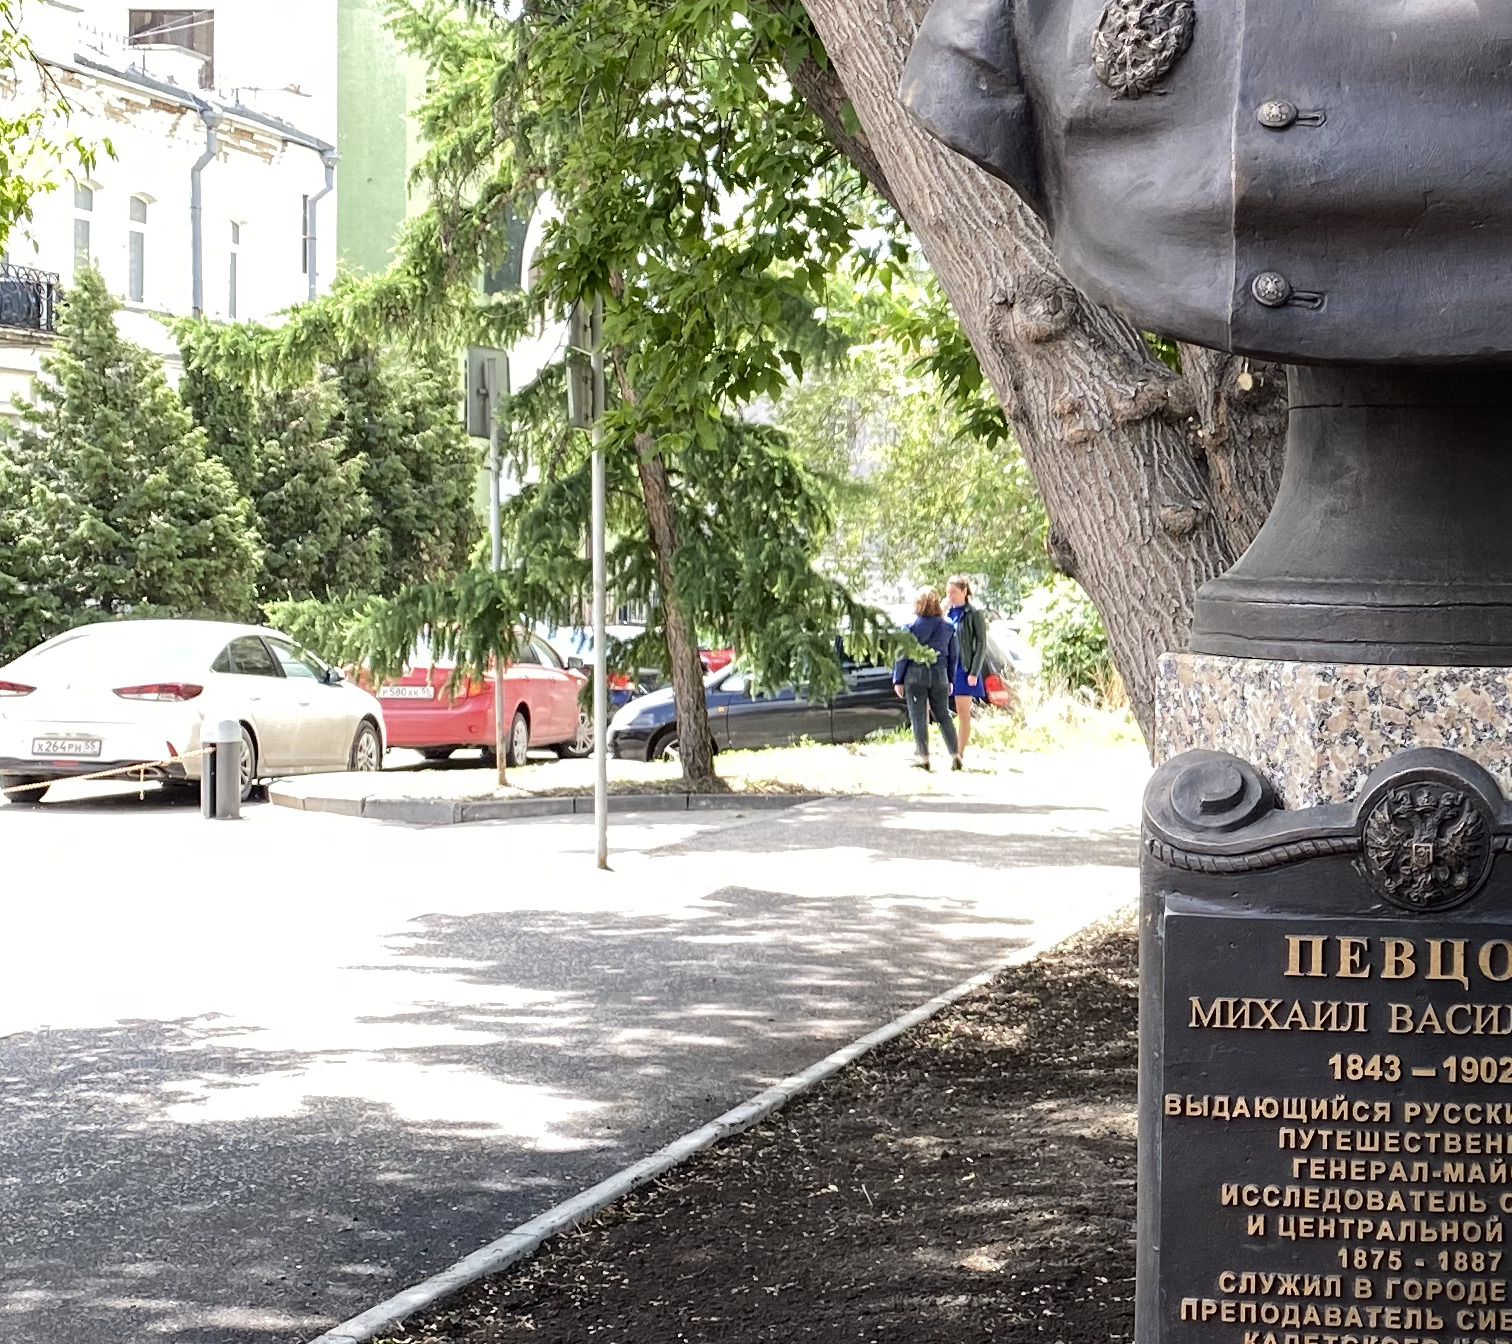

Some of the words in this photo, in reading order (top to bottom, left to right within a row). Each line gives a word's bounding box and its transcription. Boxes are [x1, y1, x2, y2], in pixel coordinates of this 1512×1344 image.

[1188, 996, 1368, 1033] МИХАИЛ
[1328, 1053, 1401, 1082] 1843
[1165, 1094, 1392, 1124] ВЫДАЮЩИЙСЯ
[1221, 1184, 1486, 1214] ИССЛЕДОВАТЕЛЬ
[1247, 1214, 1265, 1237] И
[1278, 1215, 1503, 1244] ЦЕНТРАЛЬНОЙ
[1337, 1248, 1402, 1271] 1875
[1438, 1250, 1502, 1272] 1887
[1218, 1272, 1342, 1298] СЛУЖИЛ
[1355, 1278, 1372, 1300] В
[1386, 1279, 1506, 1304] ГОРОДЕ
[1180, 1298, 1444, 1330] ПРЕПОДАВАТЕЛЬ
